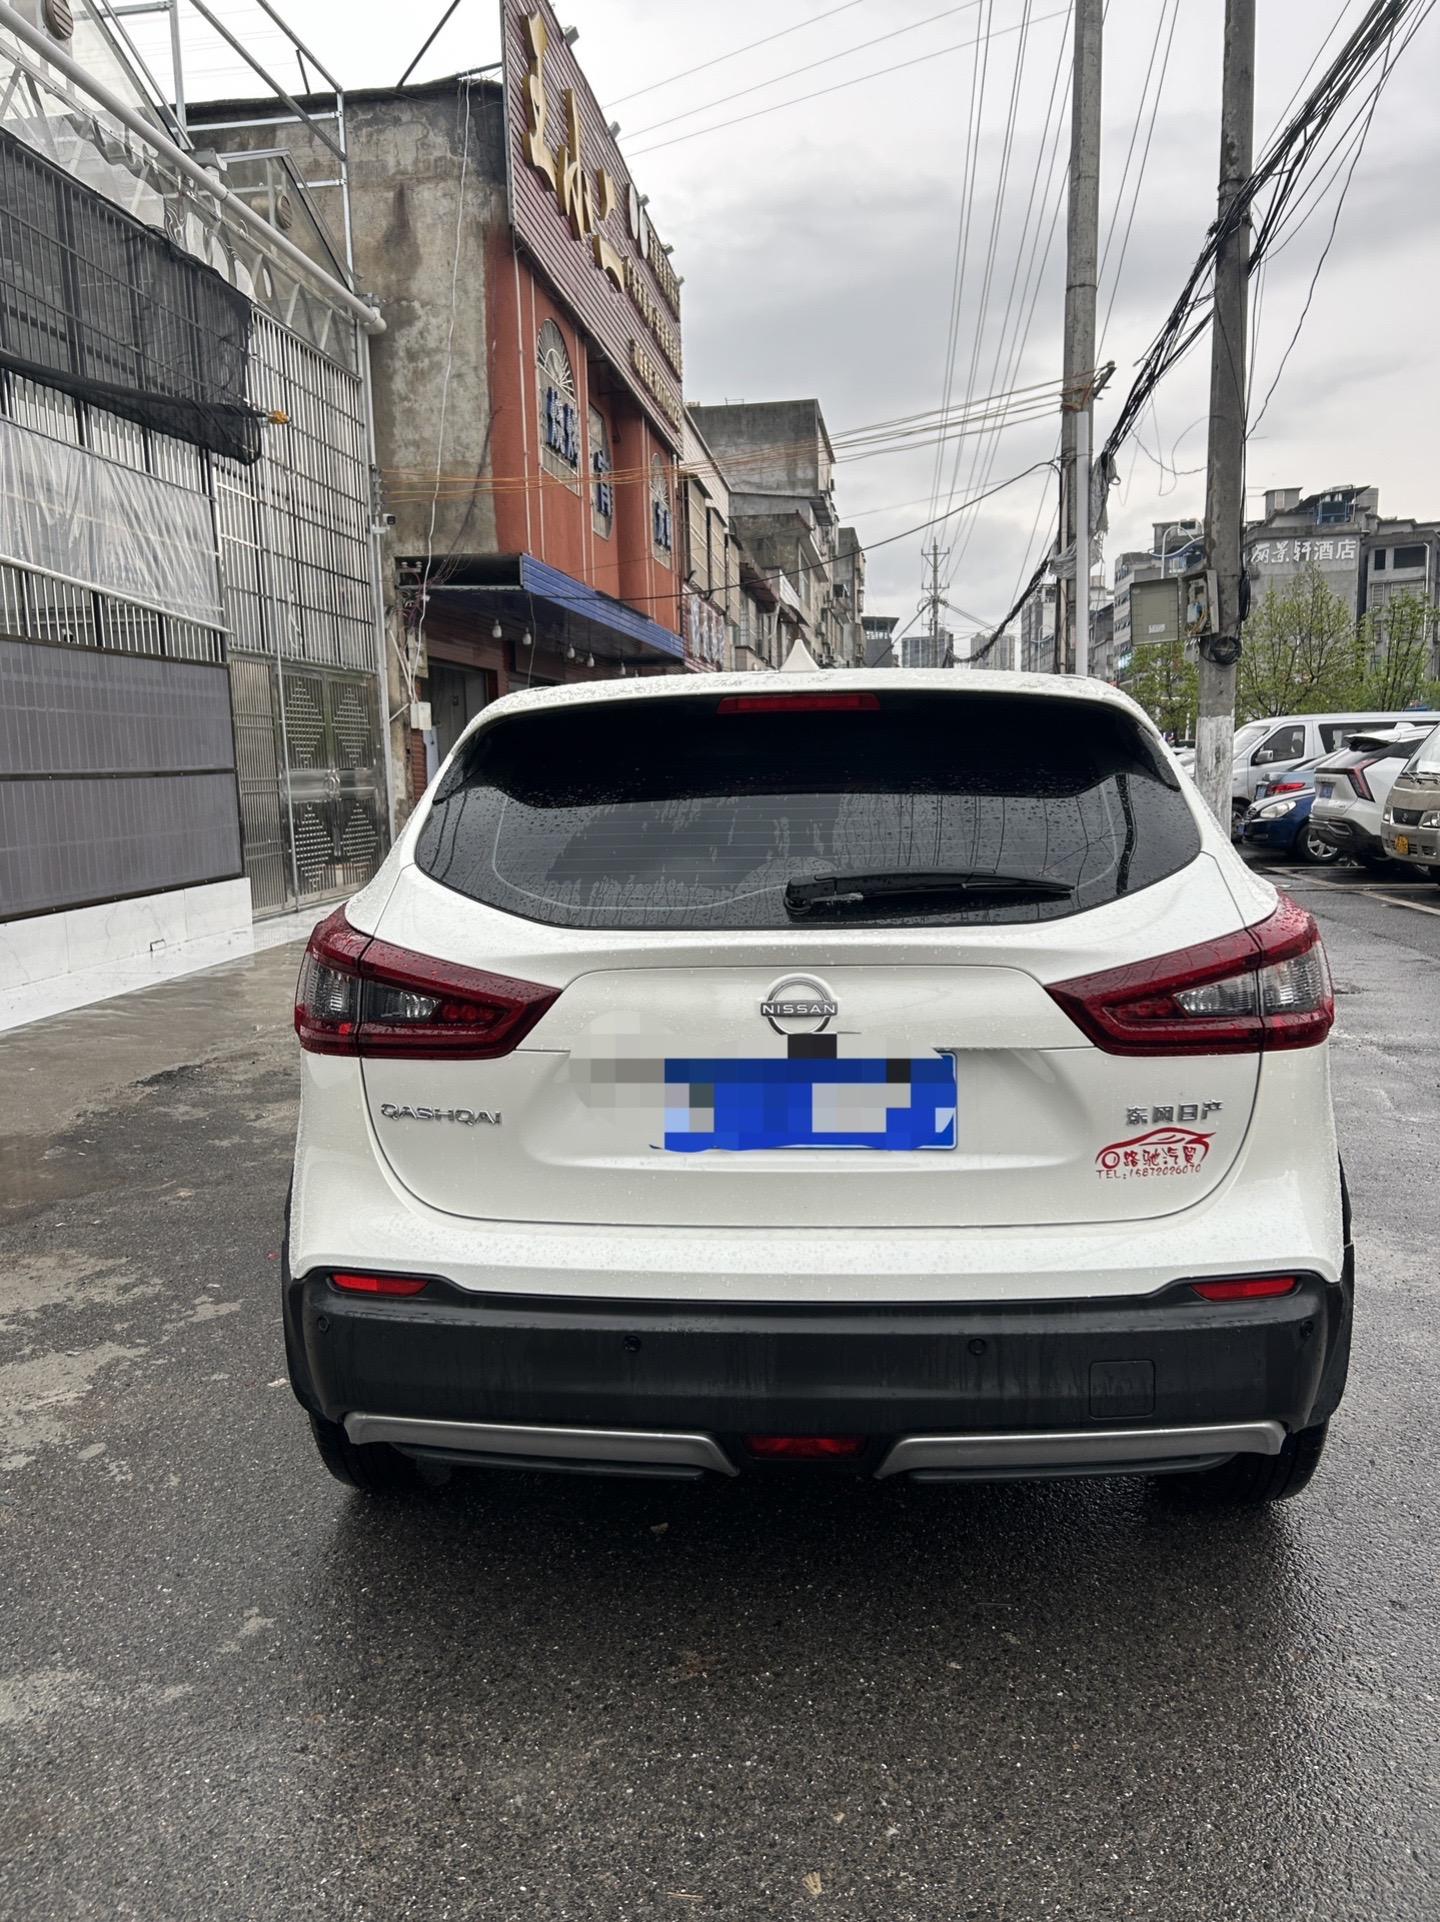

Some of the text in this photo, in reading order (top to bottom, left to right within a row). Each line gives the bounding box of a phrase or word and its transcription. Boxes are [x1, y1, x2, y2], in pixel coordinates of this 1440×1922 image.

[1250, 539, 1357, 564] 丽景轩酒店
[762, 804, 836, 814] NISSAN
[380, 1103, 502, 1126] QASHQAI
[1126, 1099, 1223, 1126] 东风日产
